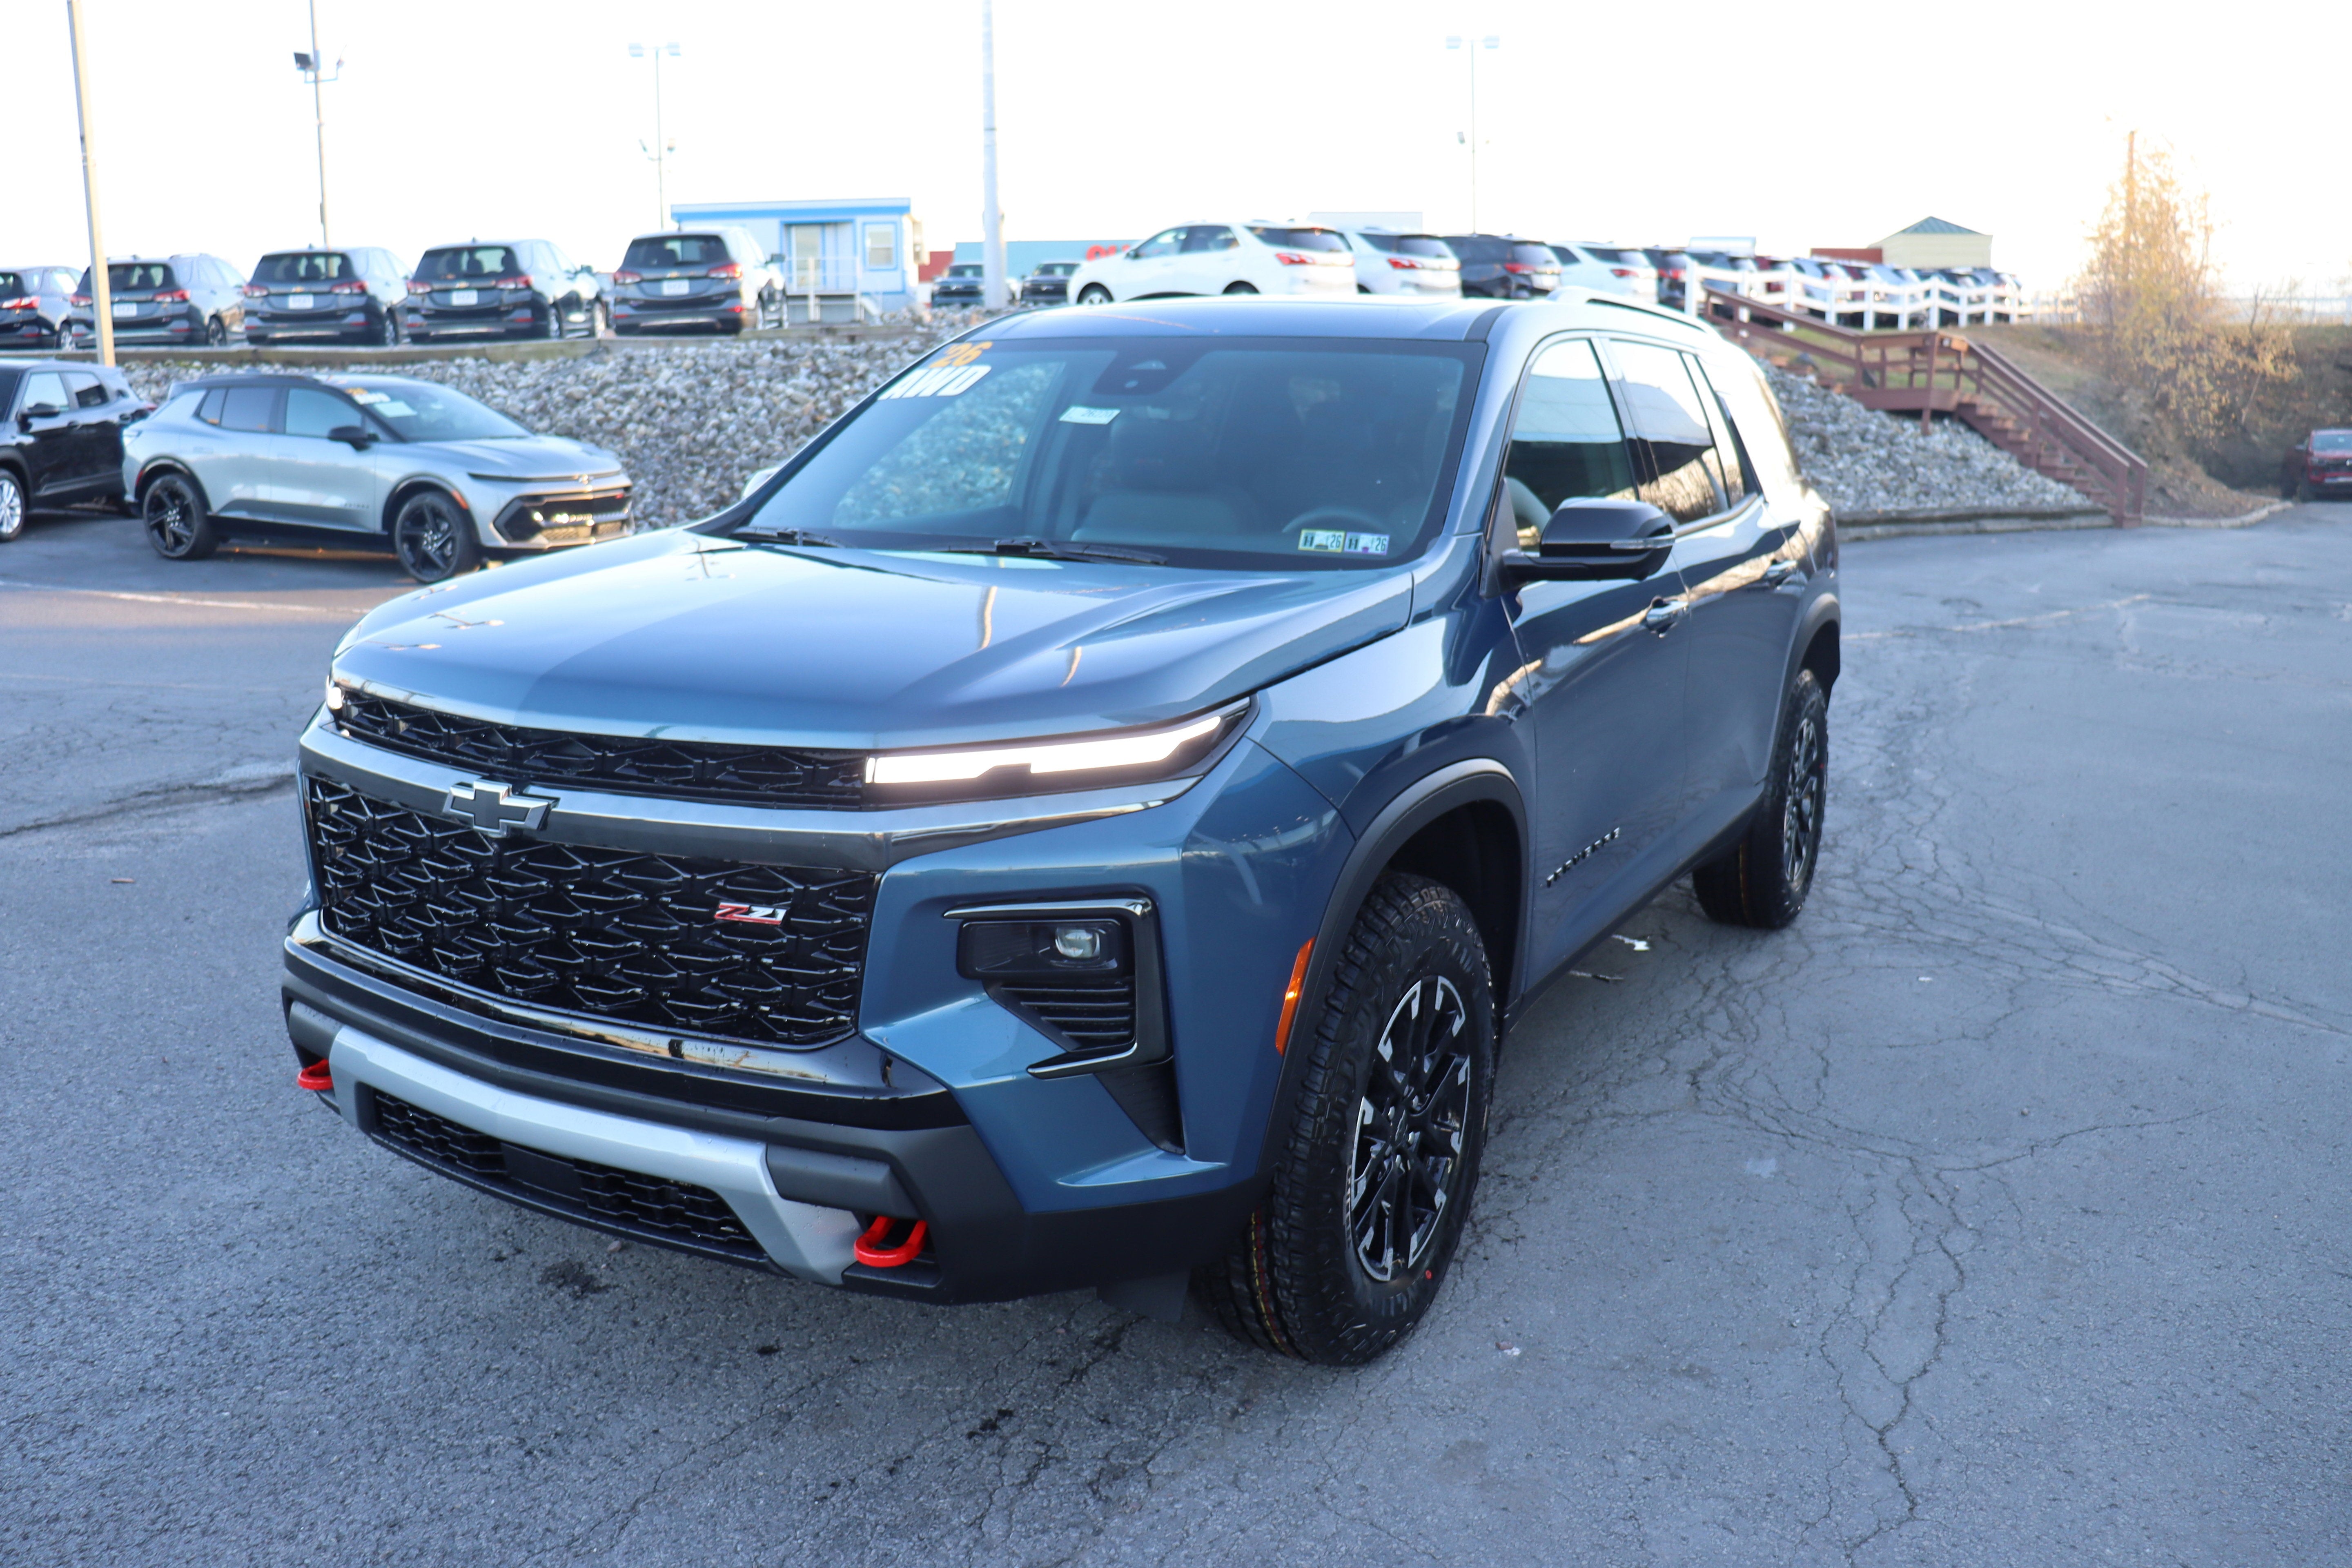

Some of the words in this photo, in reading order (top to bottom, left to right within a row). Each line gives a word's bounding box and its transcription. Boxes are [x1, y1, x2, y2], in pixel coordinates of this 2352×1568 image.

[878, 365, 992, 400] AWD
[1303, 535, 1314, 547] 11
[1330, 534, 1341, 548] 26
[1348, 538, 1359, 550] 11
[1375, 537, 1386, 552] 26
[714, 902, 787, 925] Z71
